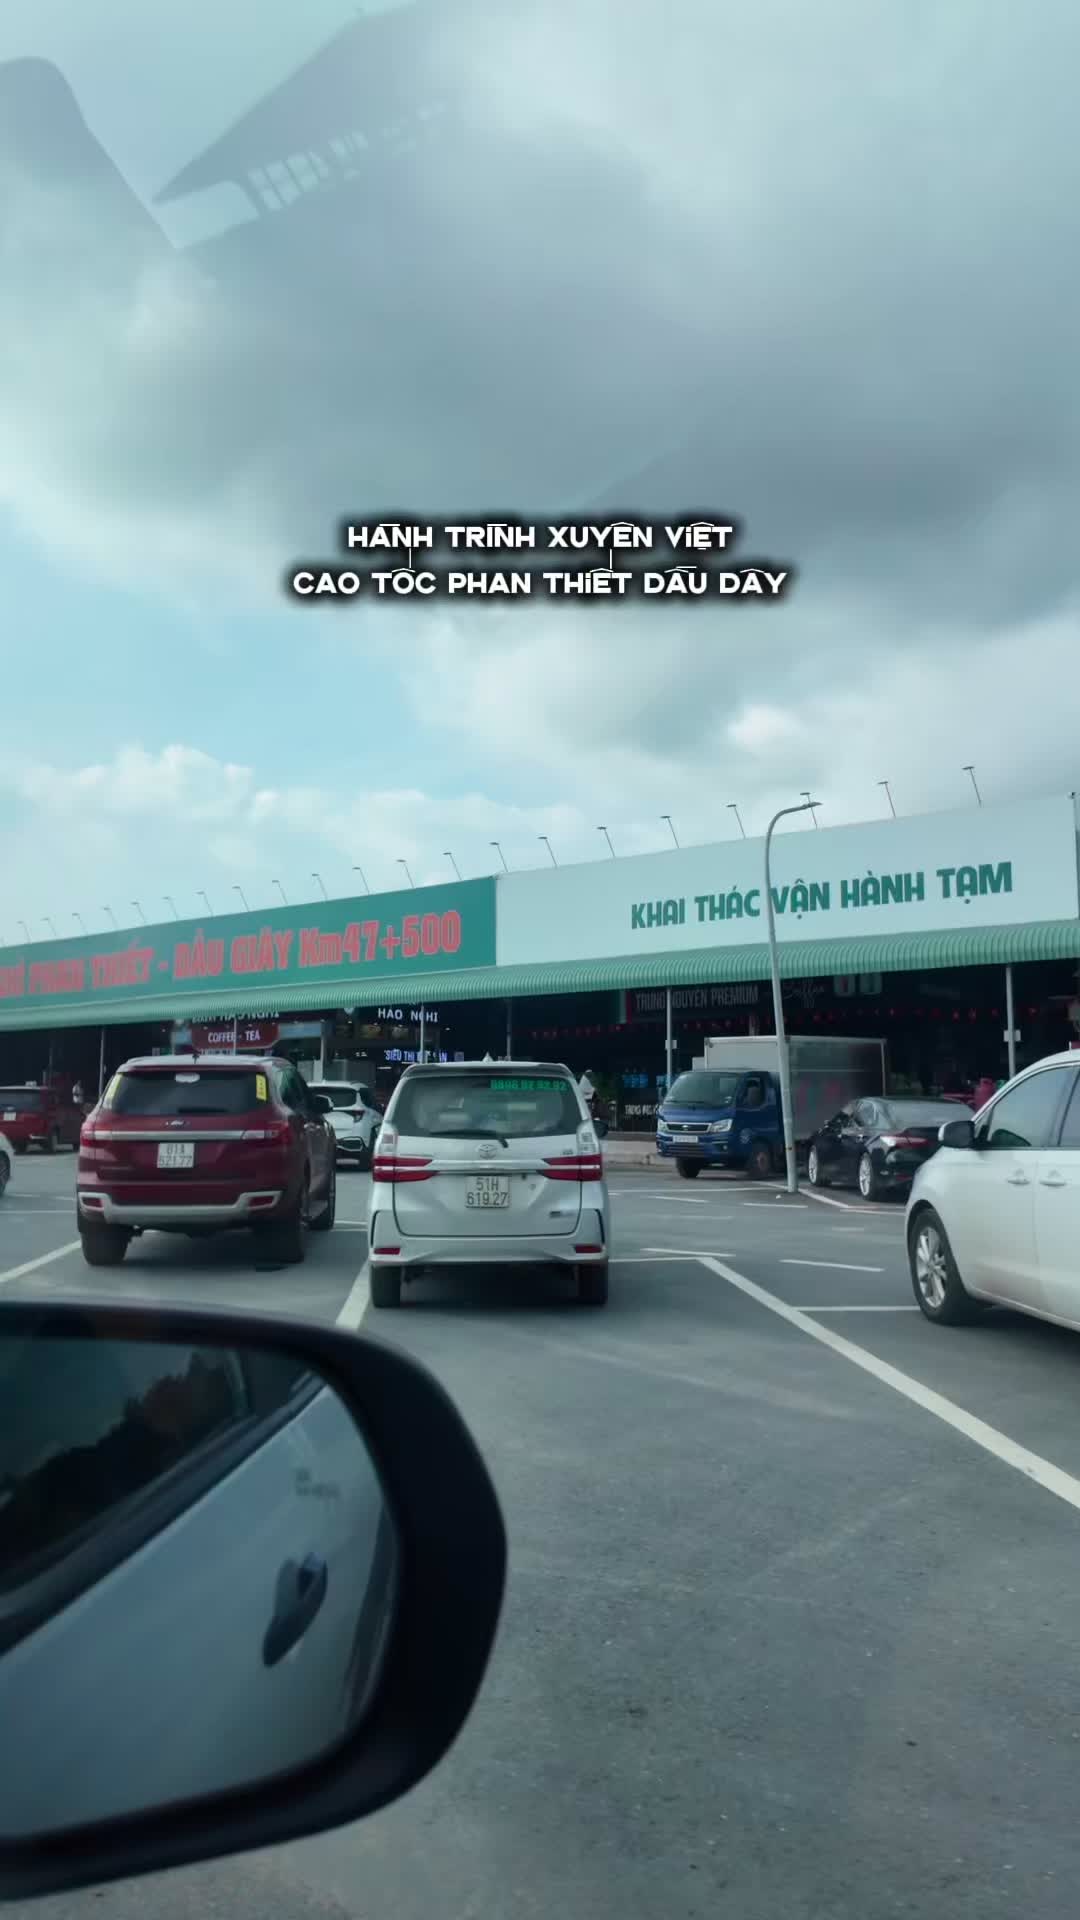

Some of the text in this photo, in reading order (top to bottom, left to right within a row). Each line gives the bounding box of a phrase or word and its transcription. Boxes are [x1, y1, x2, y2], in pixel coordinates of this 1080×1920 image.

[631, 861, 1013, 930] KHAI THÁC VẬN HÀNH TẠM
[297, 909, 462, 969] Km47+500
[245, 1029, 261, 1041] TEA
[475, 1177, 499, 1192] 51H
[466, 1191, 508, 1206] 619.27
